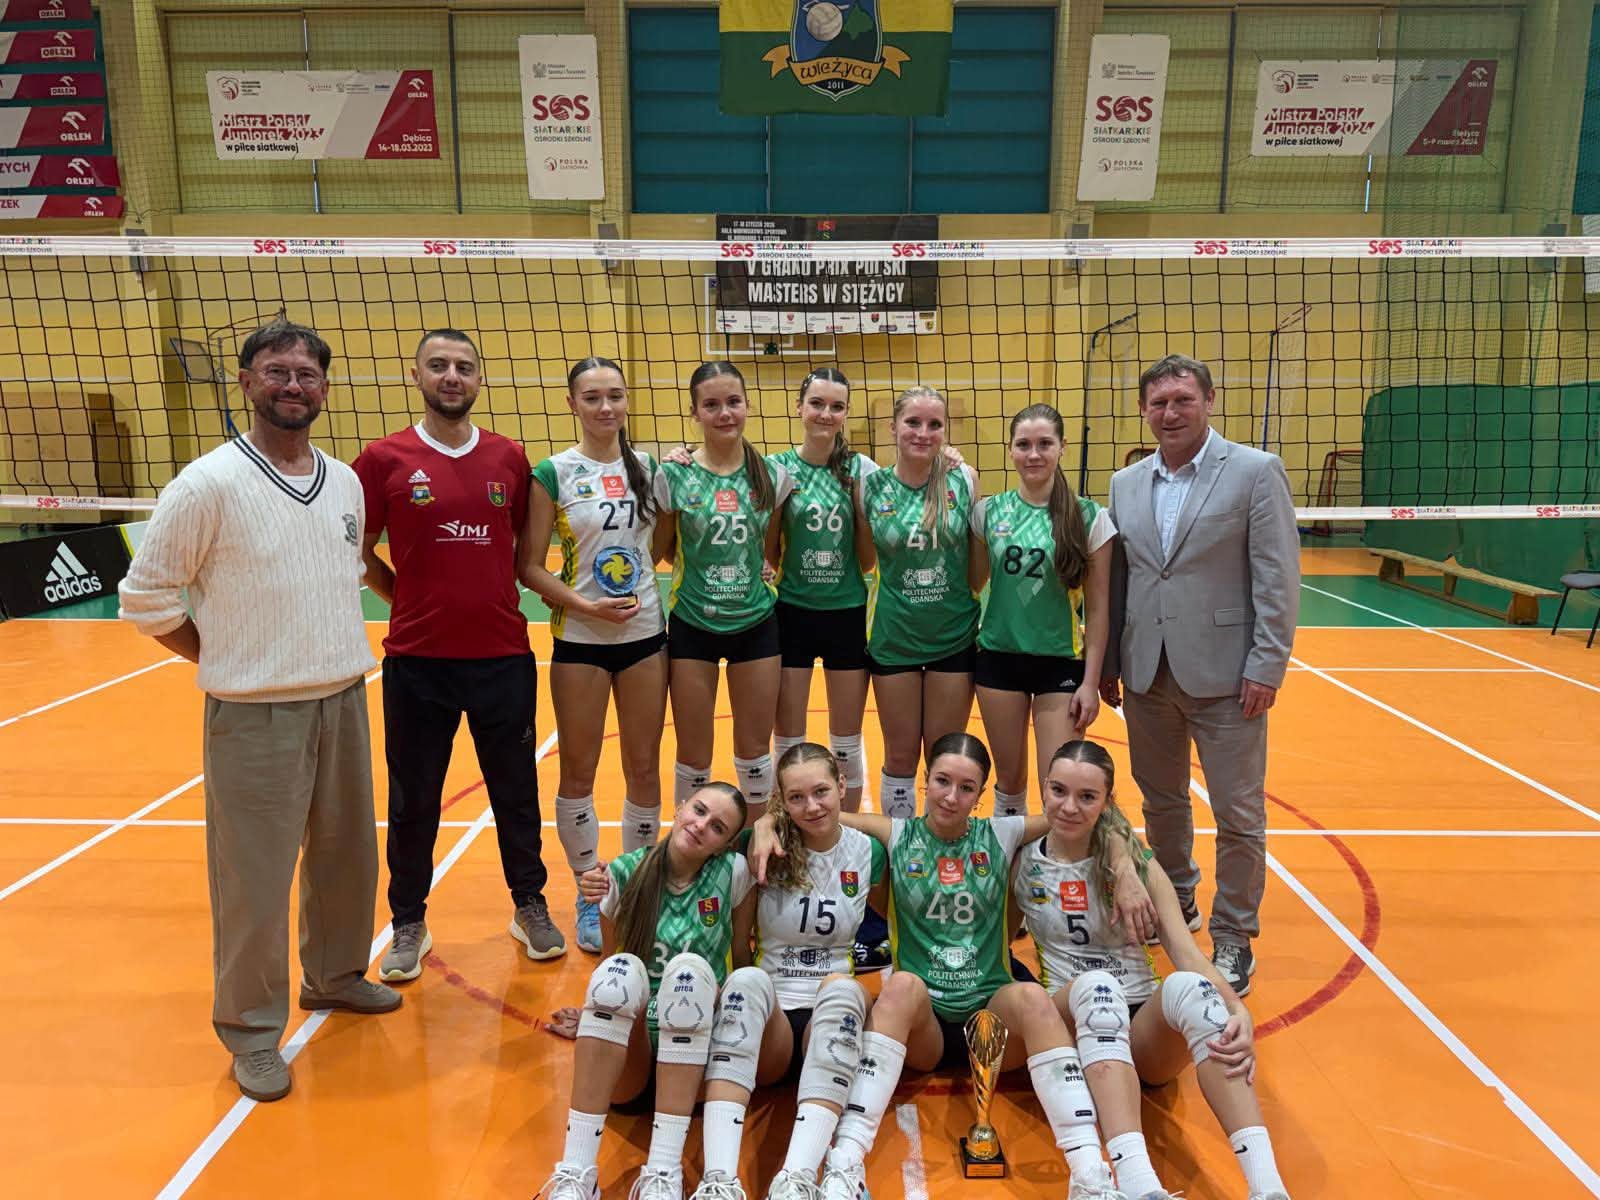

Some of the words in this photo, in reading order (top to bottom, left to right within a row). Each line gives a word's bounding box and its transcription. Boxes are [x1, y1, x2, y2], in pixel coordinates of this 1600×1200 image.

[43, 48, 74, 56] ORLEN
[827, 81, 844, 89] 2011
[532, 94, 590, 121] SOS
[1095, 95, 1153, 122] SOS
[220, 114, 262, 127] Mistrz
[266, 114, 310, 127] Polski
[1265, 108, 1313, 121] Mistrz
[1317, 108, 1364, 121] Polski
[221, 128, 287, 141] Juniorek
[534, 125, 592, 134] SIATKARSKIE
[1263, 122, 1331, 135] Juniorek
[1335, 122, 1375, 135] 2024
[60, 132, 91, 141] ORLEN
[402, 134, 432, 144] Dębica
[564, 135, 592, 143] SZKOLNE
[1298, 136, 1344, 148] siatkowej
[256, 143, 299, 153] siatkowej
[66, 177, 94, 185] ORLEN
[253, 239, 287, 254] SOS
[423, 240, 457, 255] SOS
[721, 243, 754, 258] SOS
[891, 242, 926, 258] SOS
[1194, 240, 1228, 255] SOS
[1368, 240, 1403, 255] SOS
[748, 282, 818, 304] MASTERS
[823, 282, 837, 303] W
[842, 279, 905, 308] STĘŻYCY
[37, 497, 59, 508] SOS
[599, 500, 634, 531] 27
[805, 503, 843, 532] 36
[1391, 508, 1415, 519] SOS
[1536, 506, 1560, 517] SOS
[458, 524, 490, 537] SMS
[710, 515, 748, 545] 25
[906, 523, 937, 550] 41
[1004, 545, 1046, 579] 82
[44, 575, 102, 603] adidas
[902, 586, 950, 596] POLITECHNIKA
[925, 891, 975, 925] 48
[799, 896, 836, 936] 15
[1066, 914, 1090, 946] 5
[928, 967, 985, 980] POLITECHNIKA
